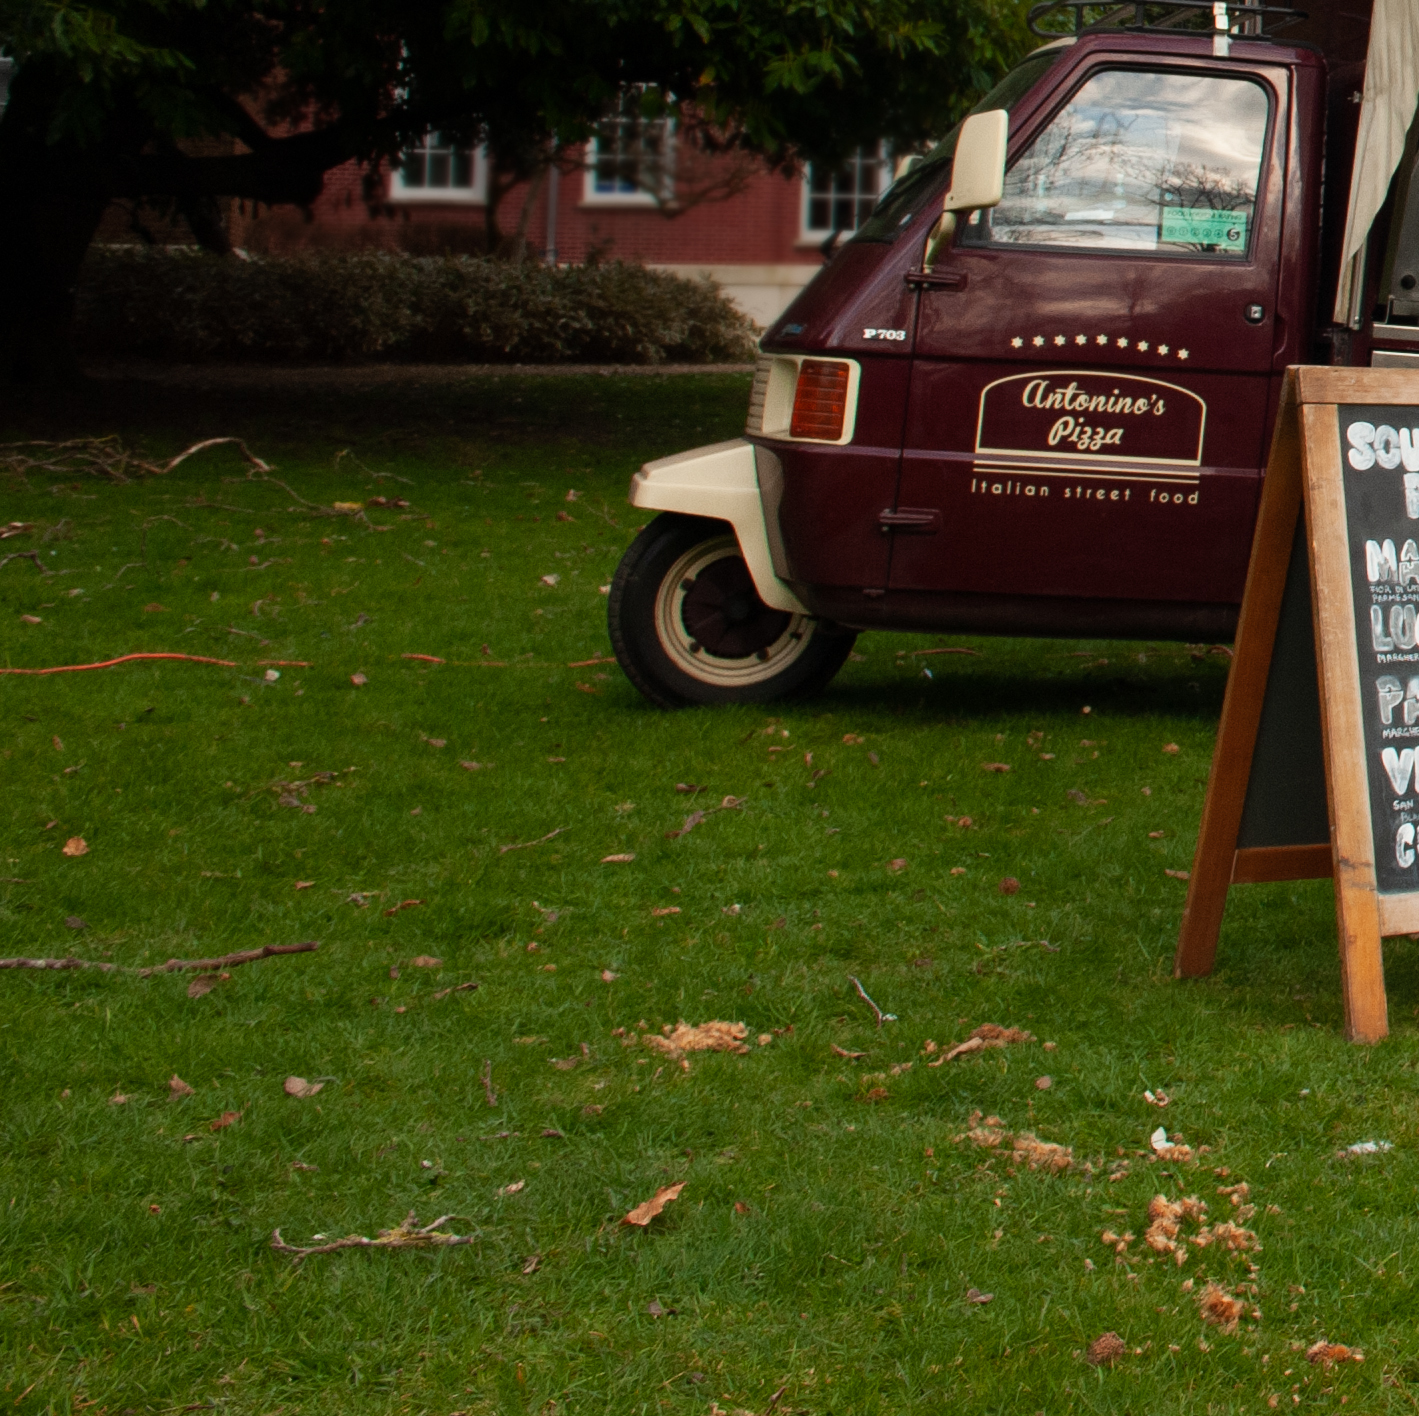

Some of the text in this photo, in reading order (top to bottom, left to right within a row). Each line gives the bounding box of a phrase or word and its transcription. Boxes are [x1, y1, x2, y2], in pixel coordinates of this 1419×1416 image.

[1022, 379, 1166, 415] Antonino's
[1048, 416, 1124, 450] Pizza
[971, 478, 1200, 505] Italian street food
[1393, 799, 1413, 811] SAN
